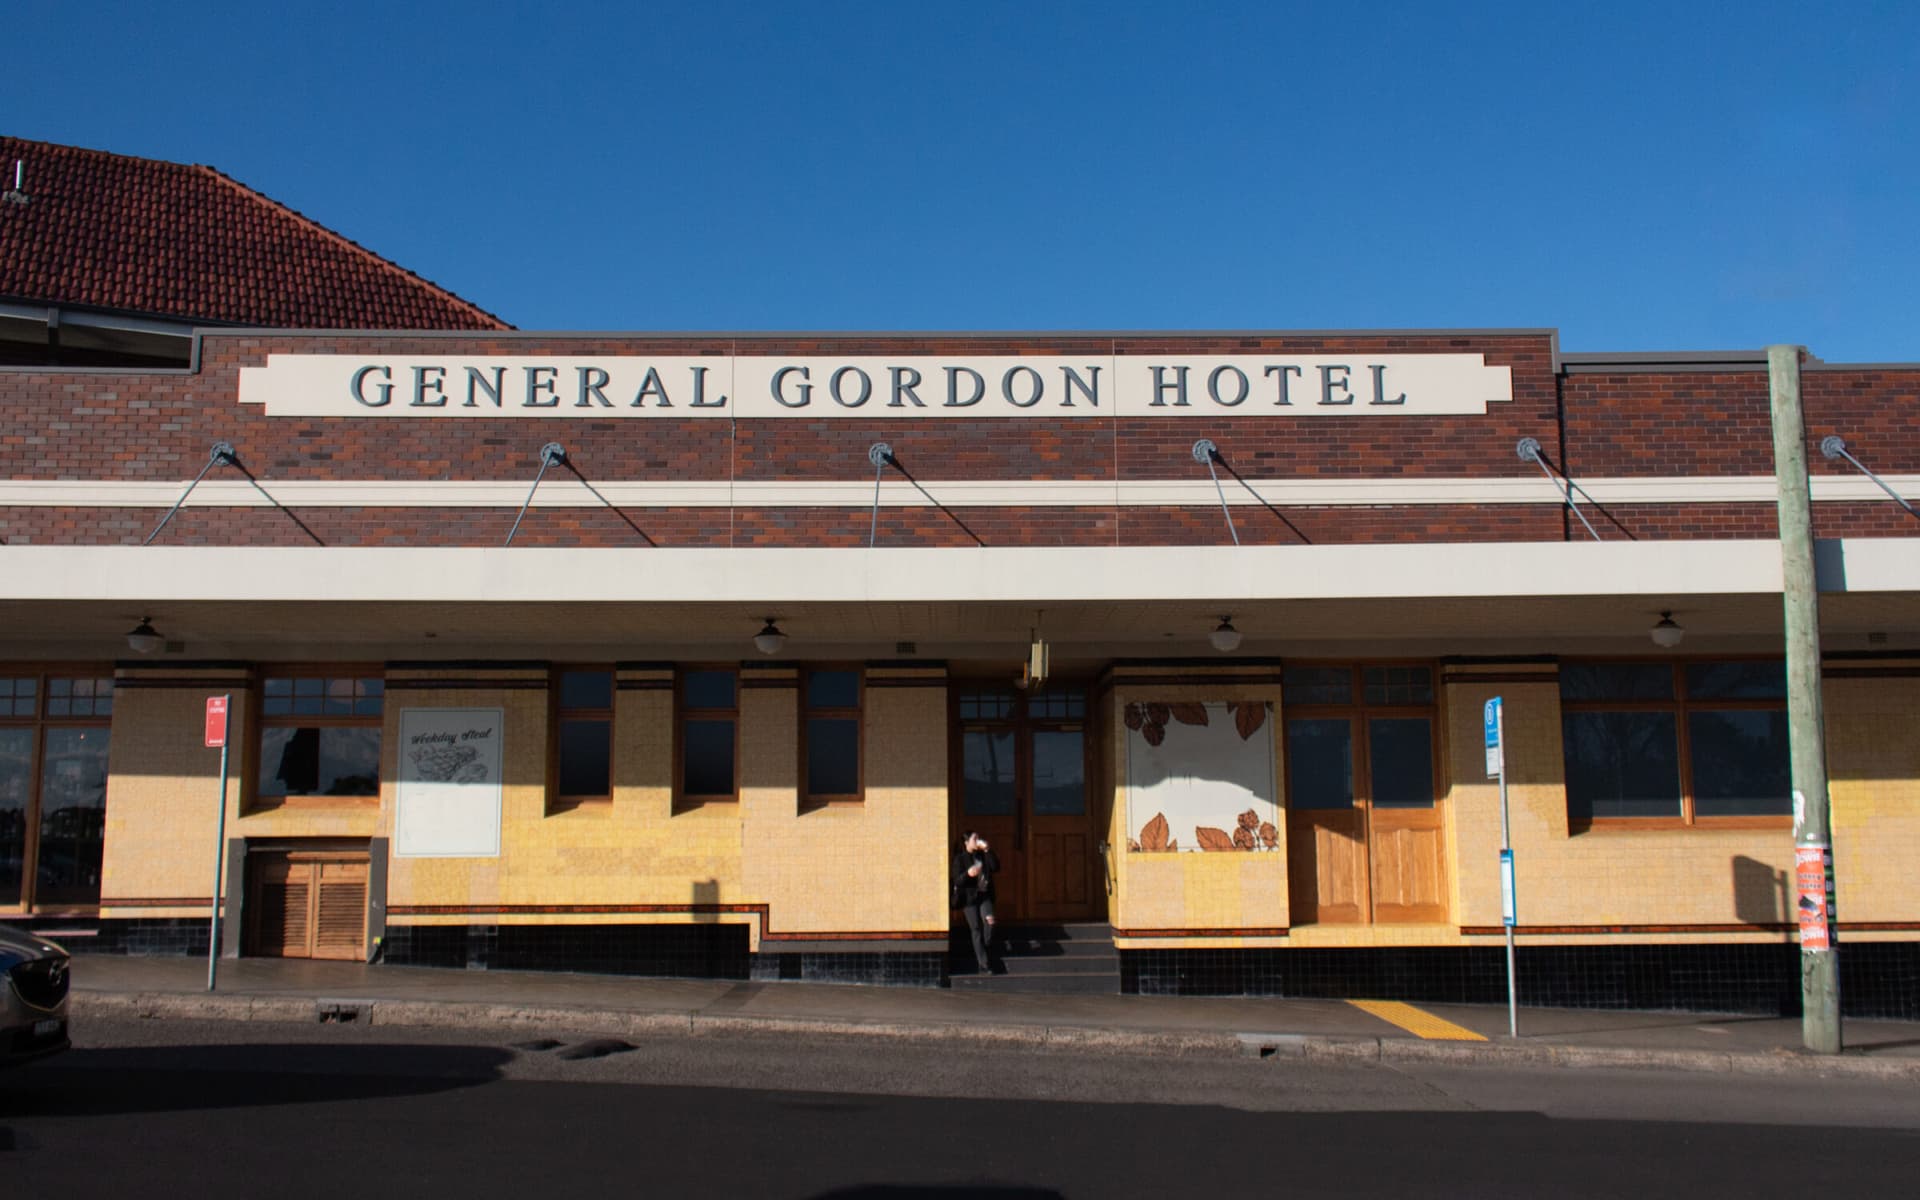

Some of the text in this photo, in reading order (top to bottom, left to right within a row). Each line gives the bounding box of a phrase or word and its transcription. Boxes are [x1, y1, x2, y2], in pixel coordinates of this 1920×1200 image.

[350, 364, 1407, 408] GENERAL GORDON HOTEL
[411, 732, 457, 745] Weekday
